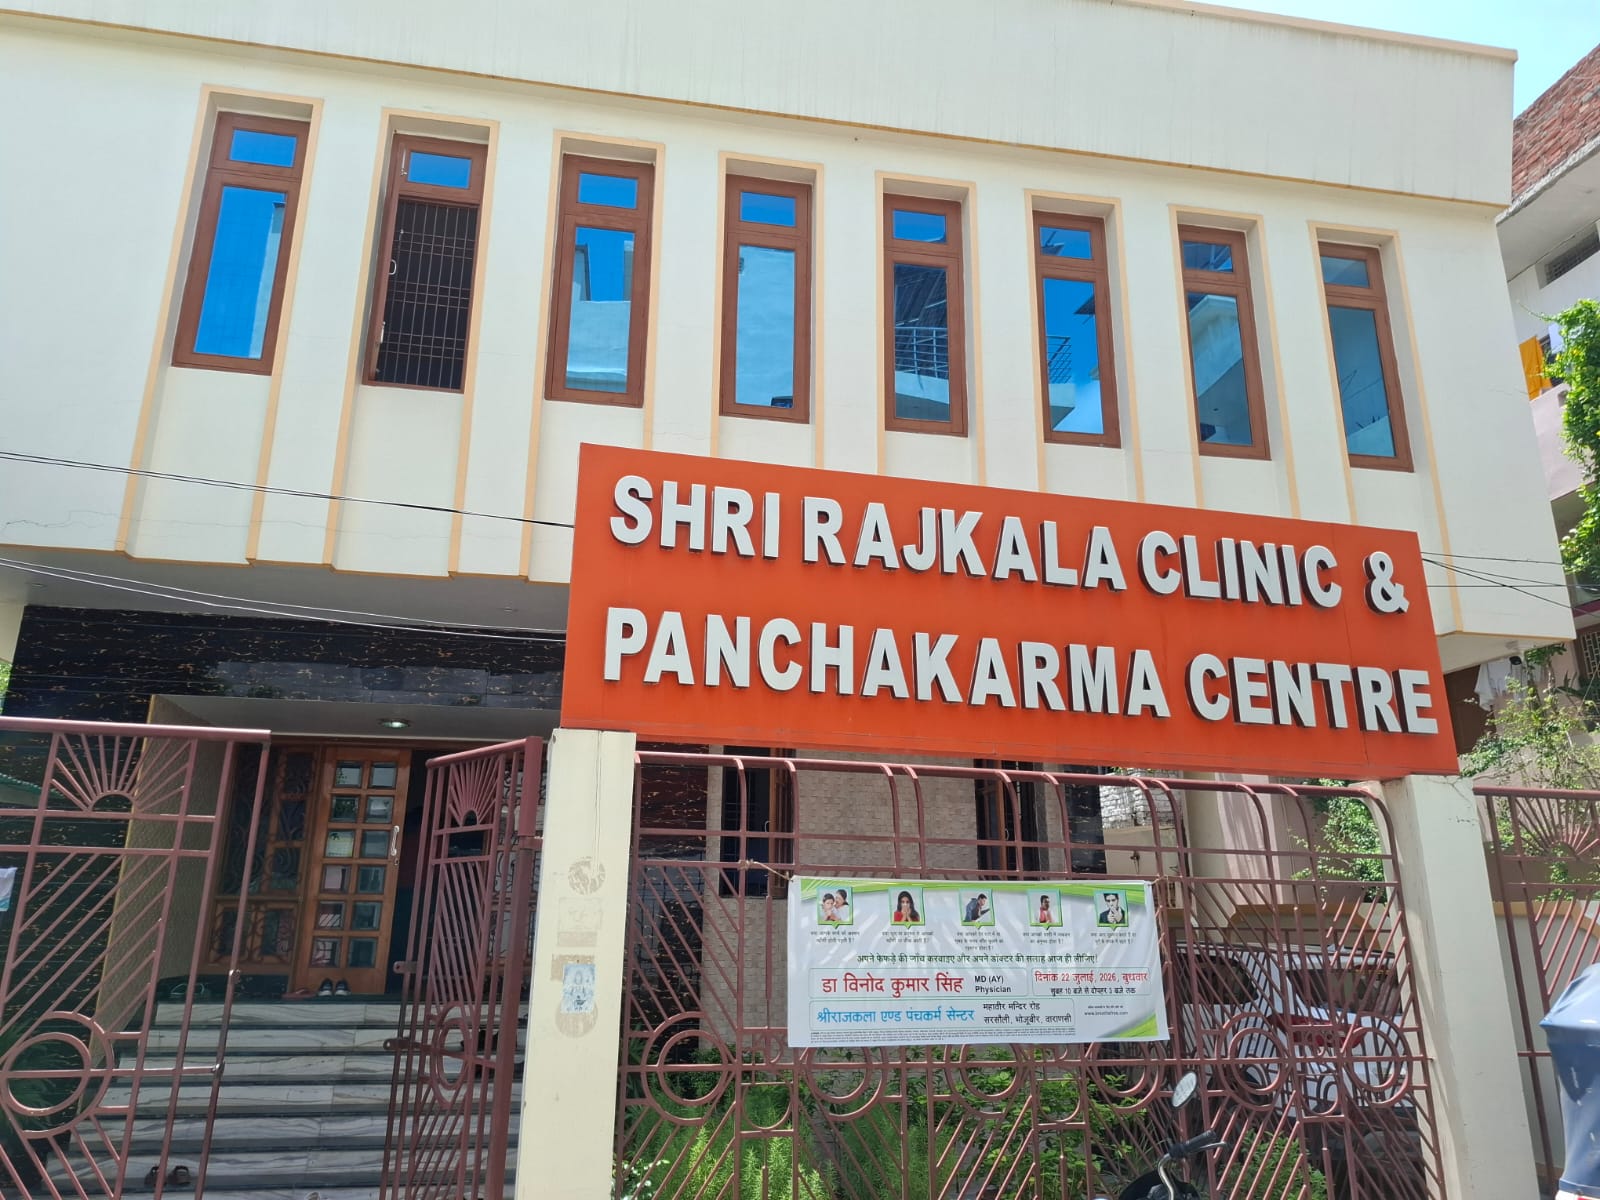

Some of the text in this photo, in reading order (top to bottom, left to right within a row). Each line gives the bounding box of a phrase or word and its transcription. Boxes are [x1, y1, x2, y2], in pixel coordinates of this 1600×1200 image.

[609, 474, 1410, 614] SHRI RAJKALA CLINIC &
[603, 606, 1439, 734] PANCHAKARMA CENTRE
[857, 953, 875, 963] अपने
[899, 953, 908, 962] की
[958, 953, 971, 962] और
[973, 953, 989, 963] अपने
[1016, 953, 1024, 962] की
[1048, 955, 1063, 963] आज
[1064, 953, 1072, 964] ही
[974, 975, 1004, 984] MD (AY)
[1034, 970, 1058, 982] दिनांक
[1061, 973, 1070, 982] 22
[1099, 973, 1120, 983] 2026,
[1121, 972, 1148, 985] बुधवार
[821, 971, 964, 998] डा विनोद कुमार सिंह
[975, 985, 1012, 994] Physician
[1073, 985, 1083, 994] बजे
[1114, 986, 1124, 994] बजे
[1029, 1001, 1041, 1010] रोड
[817, 1006, 976, 1023] श्रीराजकला एण्ड पंचकर्म सेन्टर
